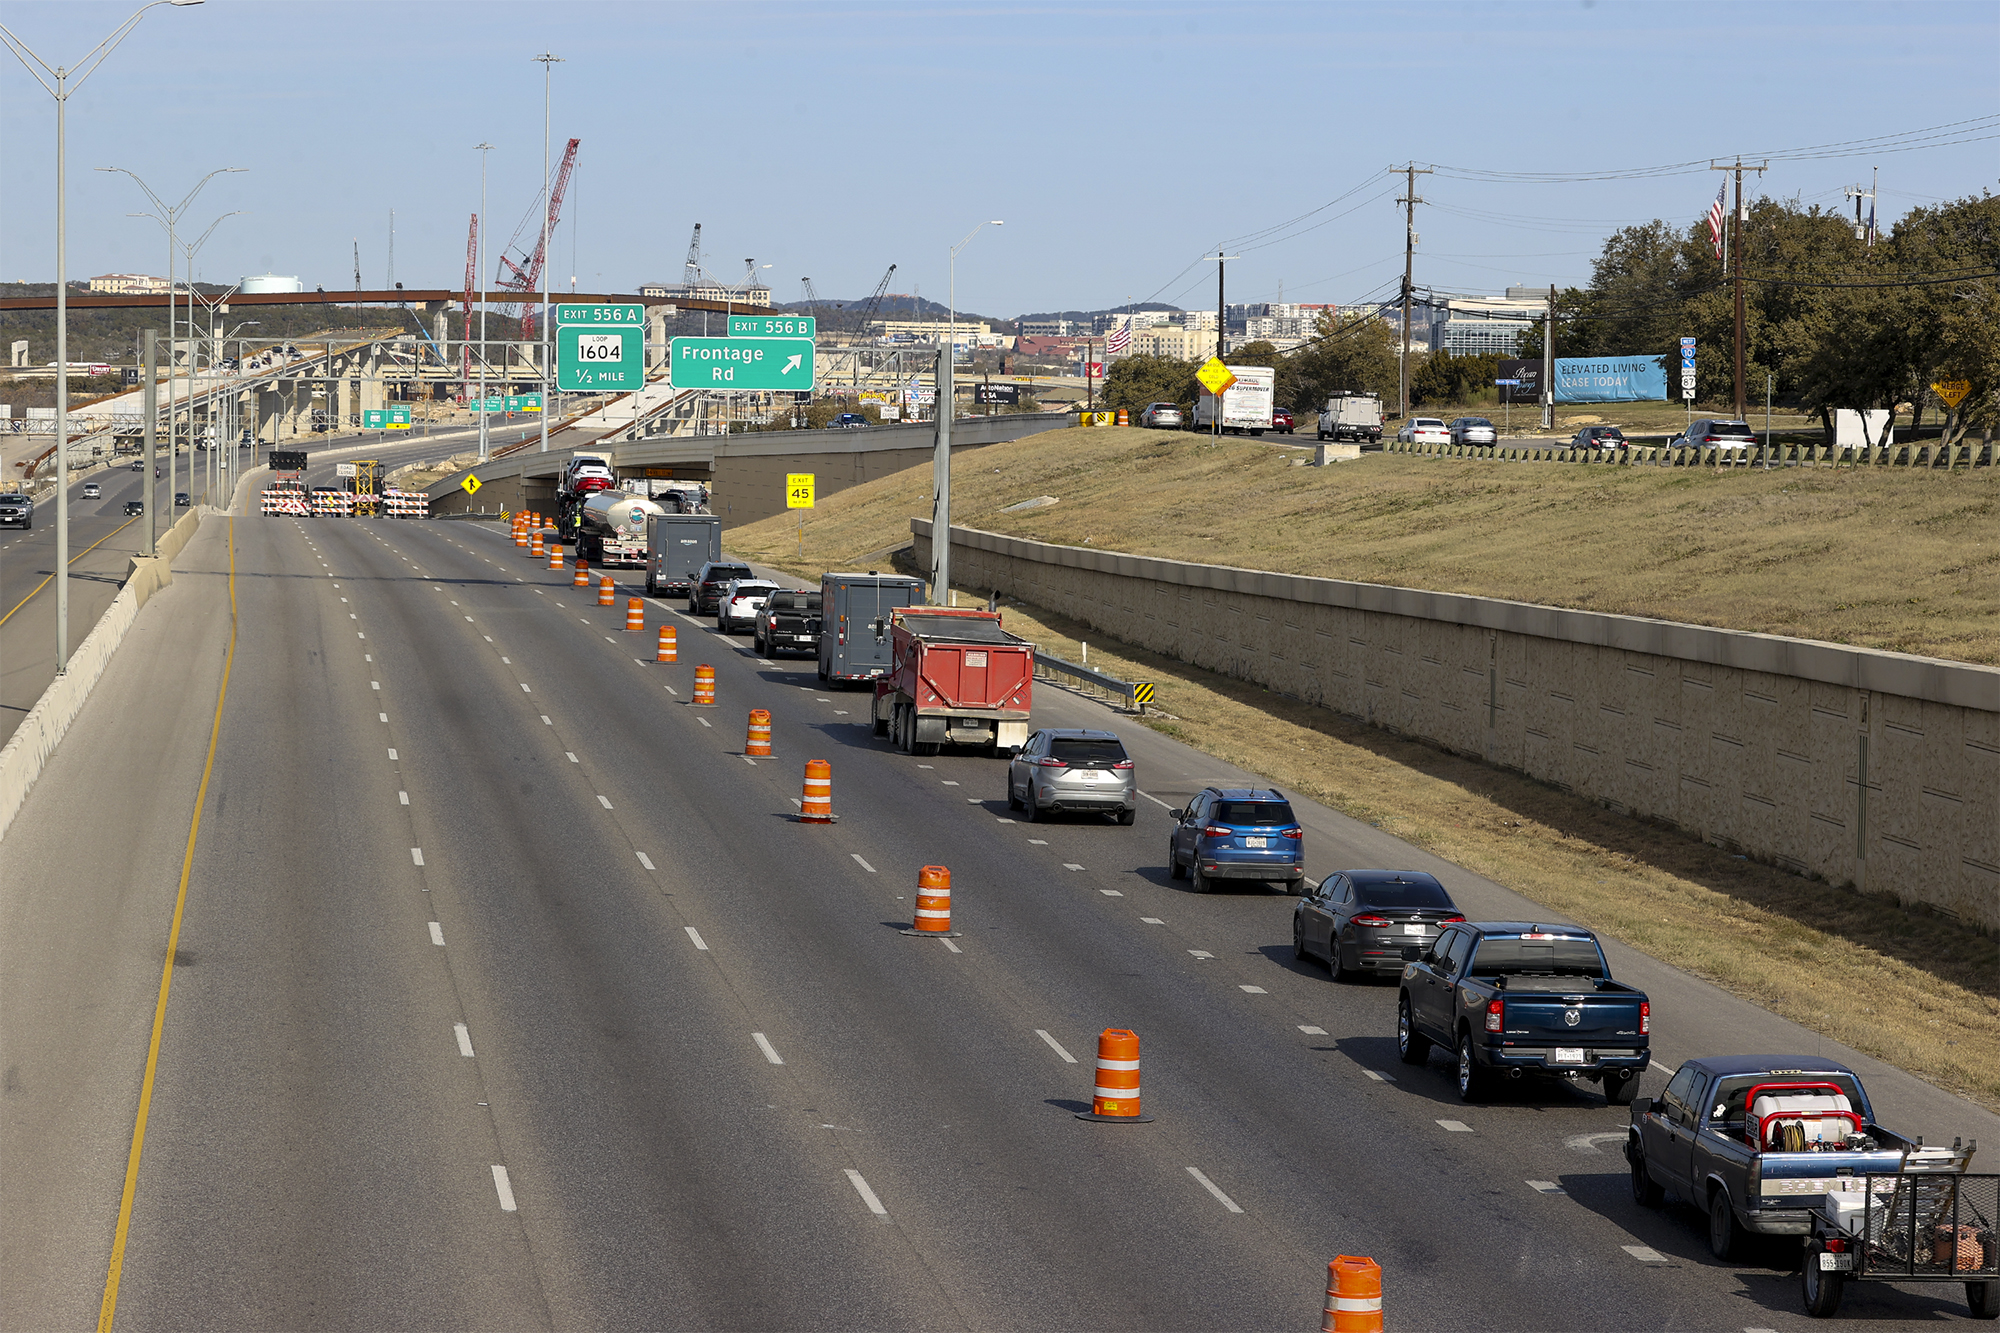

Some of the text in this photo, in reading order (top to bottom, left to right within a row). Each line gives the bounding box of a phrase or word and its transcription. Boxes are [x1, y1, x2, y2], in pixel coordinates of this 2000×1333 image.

[563, 308, 637, 321] EXIT 556 A
[734, 321, 808, 334] EXIT 556 B
[580, 345, 620, 359] 1604
[682, 346, 764, 364] Frontage
[1684, 349, 1693, 357] 10
[712, 367, 734, 380] Rd
[1561, 363, 1646, 375] ELEVATED LIVING
[598, 372, 625, 381] MILE
[1561, 376, 1629, 388] LEASE TODAY
[1683, 378, 1694, 387] 87
[791, 488, 809, 499] 45
